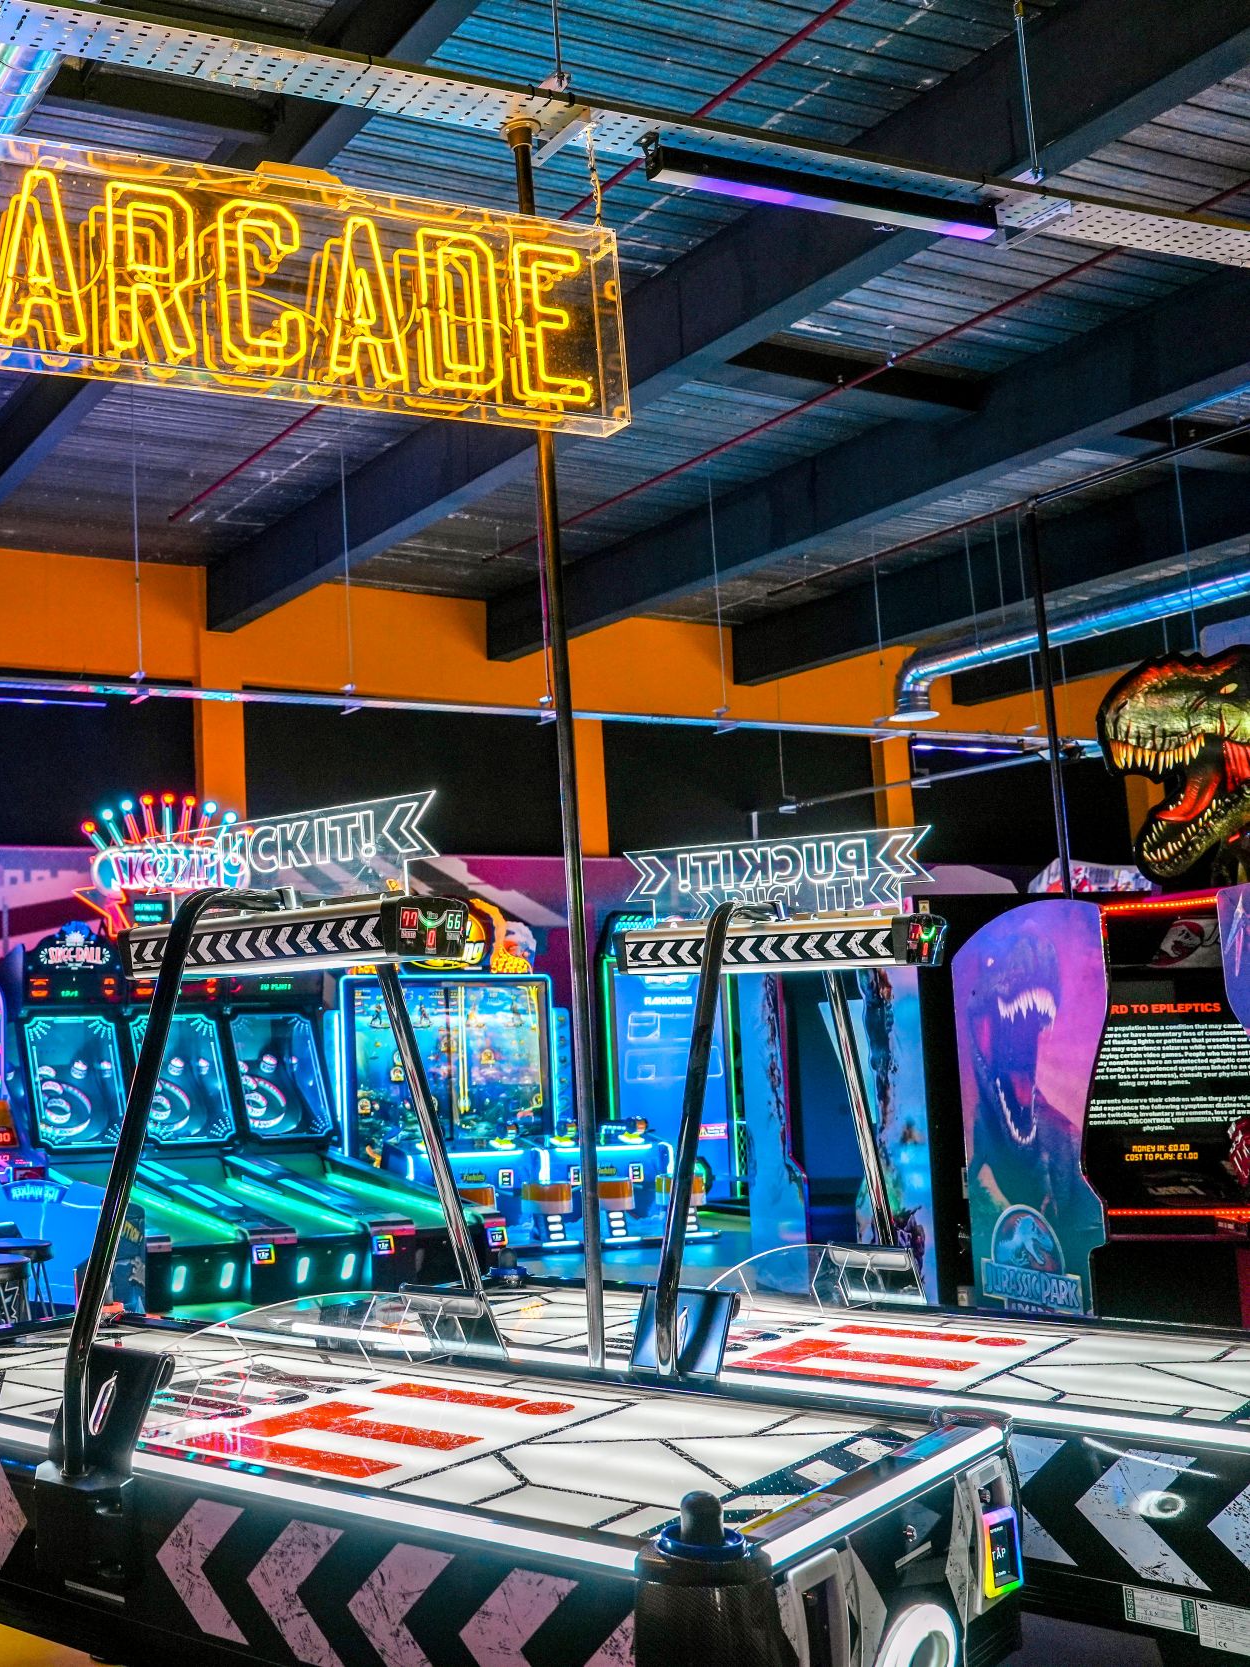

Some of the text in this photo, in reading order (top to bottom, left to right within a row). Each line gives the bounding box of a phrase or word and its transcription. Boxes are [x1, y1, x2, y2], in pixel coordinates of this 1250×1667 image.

[194, 810, 377, 883] PUCK IT!
[446, 913, 462, 929] 66
[427, 930, 436, 946] 0
[643, 996, 693, 1006] RANKINGS
[1131, 1002, 1222, 1014] TO EPILEPTICS
[1132, 1144, 1156, 1153] MONEY
[1125, 1153, 1143, 1162] COST
[1144, 1153, 1154, 1161] TO
[1154, 1152, 1176, 1161] PLAY:
[985, 1262, 1080, 1308] JURASSIC PARK
[991, 1546, 1007, 1561] TAP
[1125, 1588, 1136, 1620] PASSED
